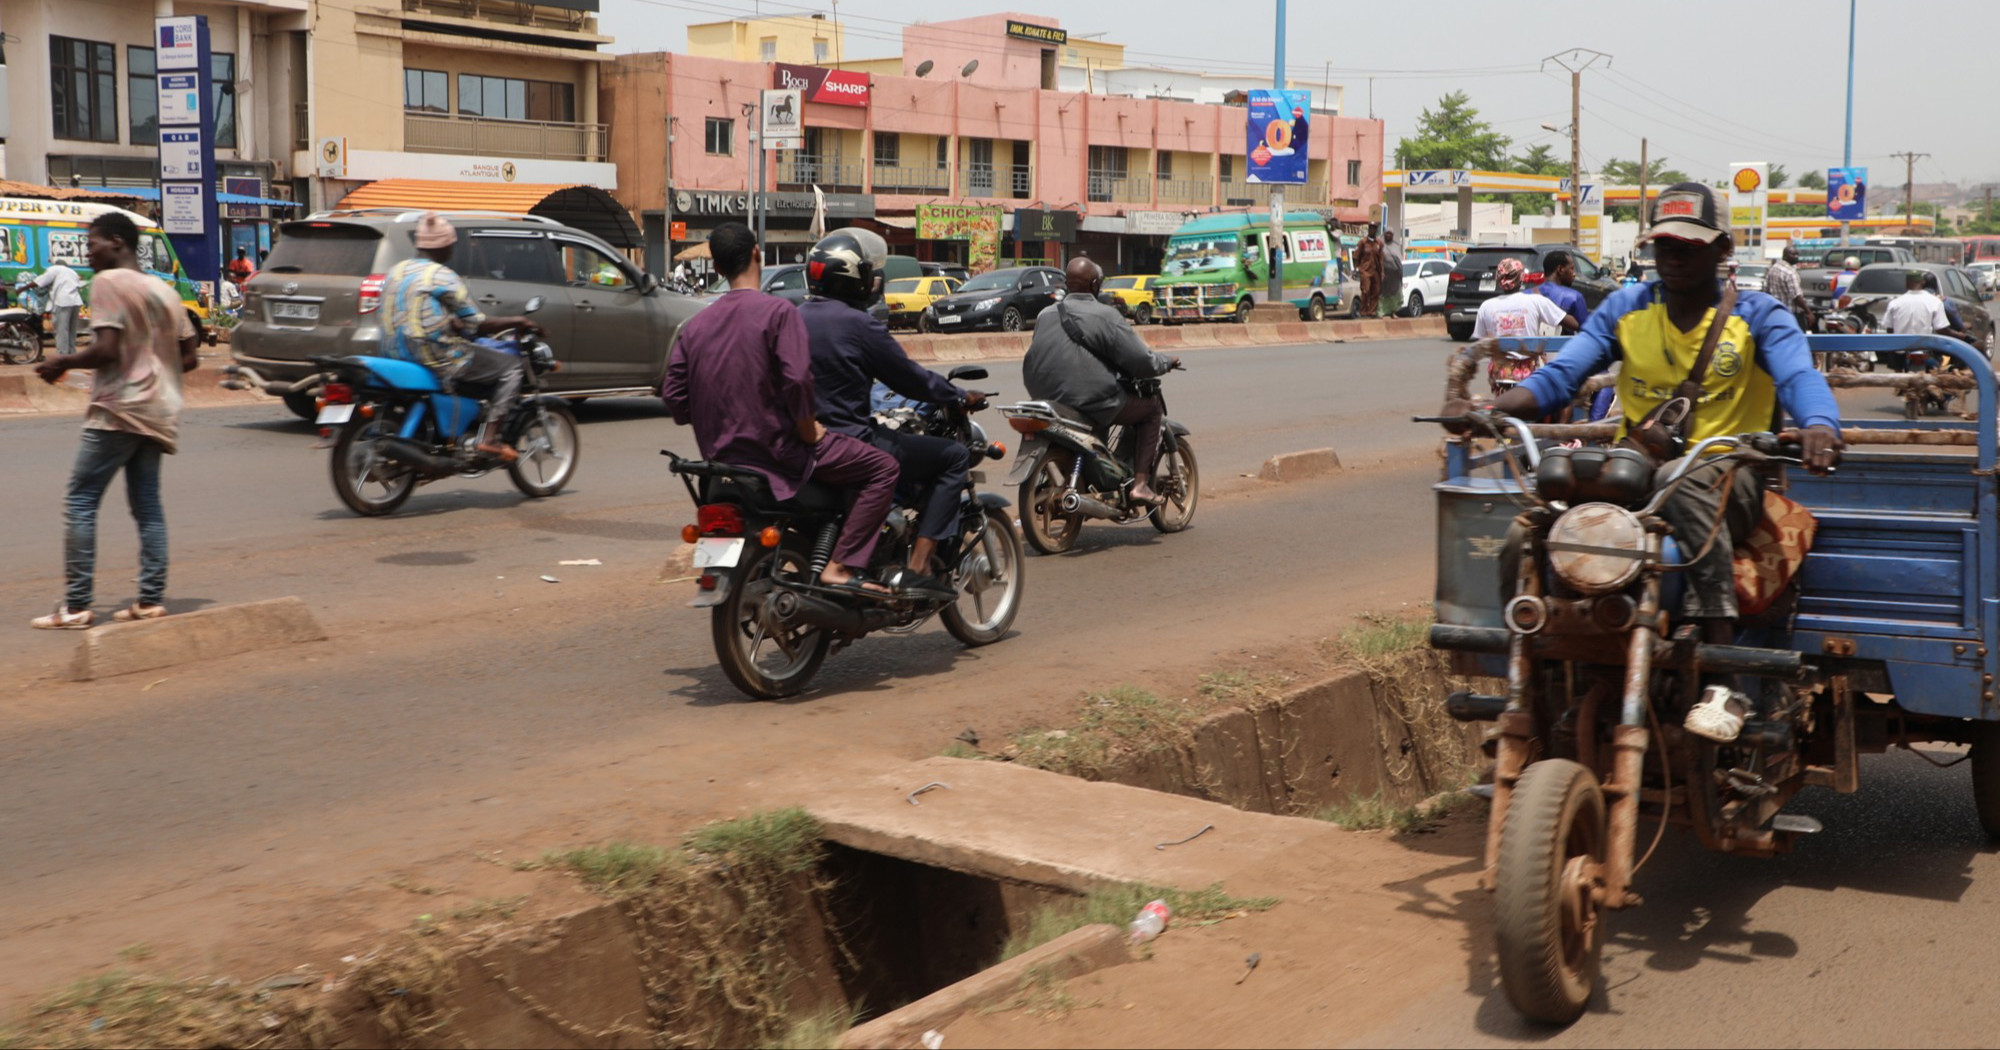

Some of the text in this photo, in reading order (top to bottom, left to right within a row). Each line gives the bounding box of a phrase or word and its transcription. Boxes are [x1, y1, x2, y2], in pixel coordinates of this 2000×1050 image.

[175, 33, 192, 42] BANK
[825, 81, 867, 95] SHARP
[460, 170, 499, 178] ATLANTIQUE
[696, 193, 733, 214] TMK
[1042, 215, 1054, 231] BK
